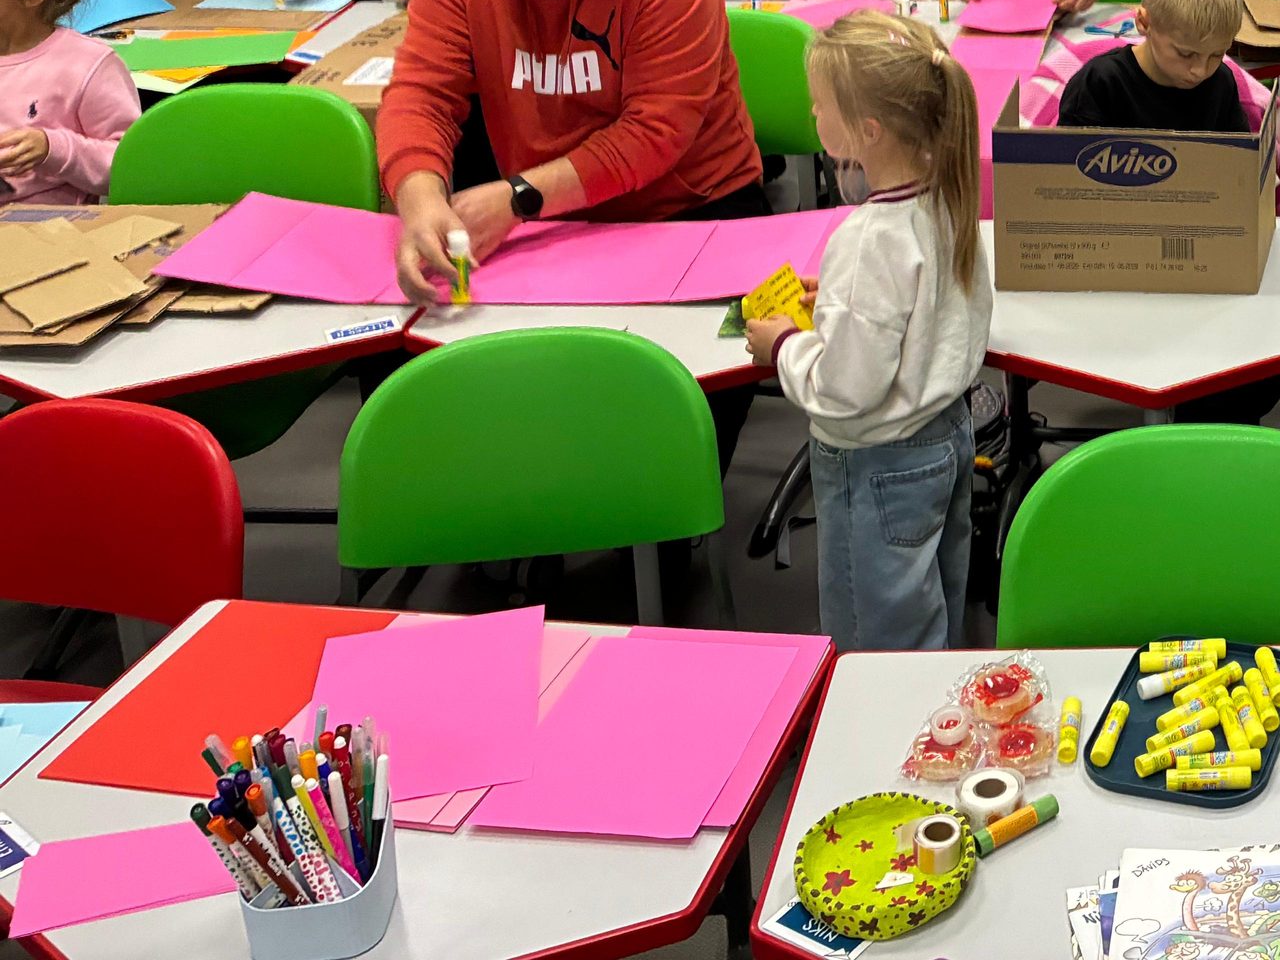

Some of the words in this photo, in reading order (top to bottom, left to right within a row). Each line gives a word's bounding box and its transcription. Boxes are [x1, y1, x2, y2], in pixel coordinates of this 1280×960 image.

[511, 48, 602, 95] PUMA
[1082, 145, 1174, 177] Aviko
[802, 917, 840, 943] NIKS
